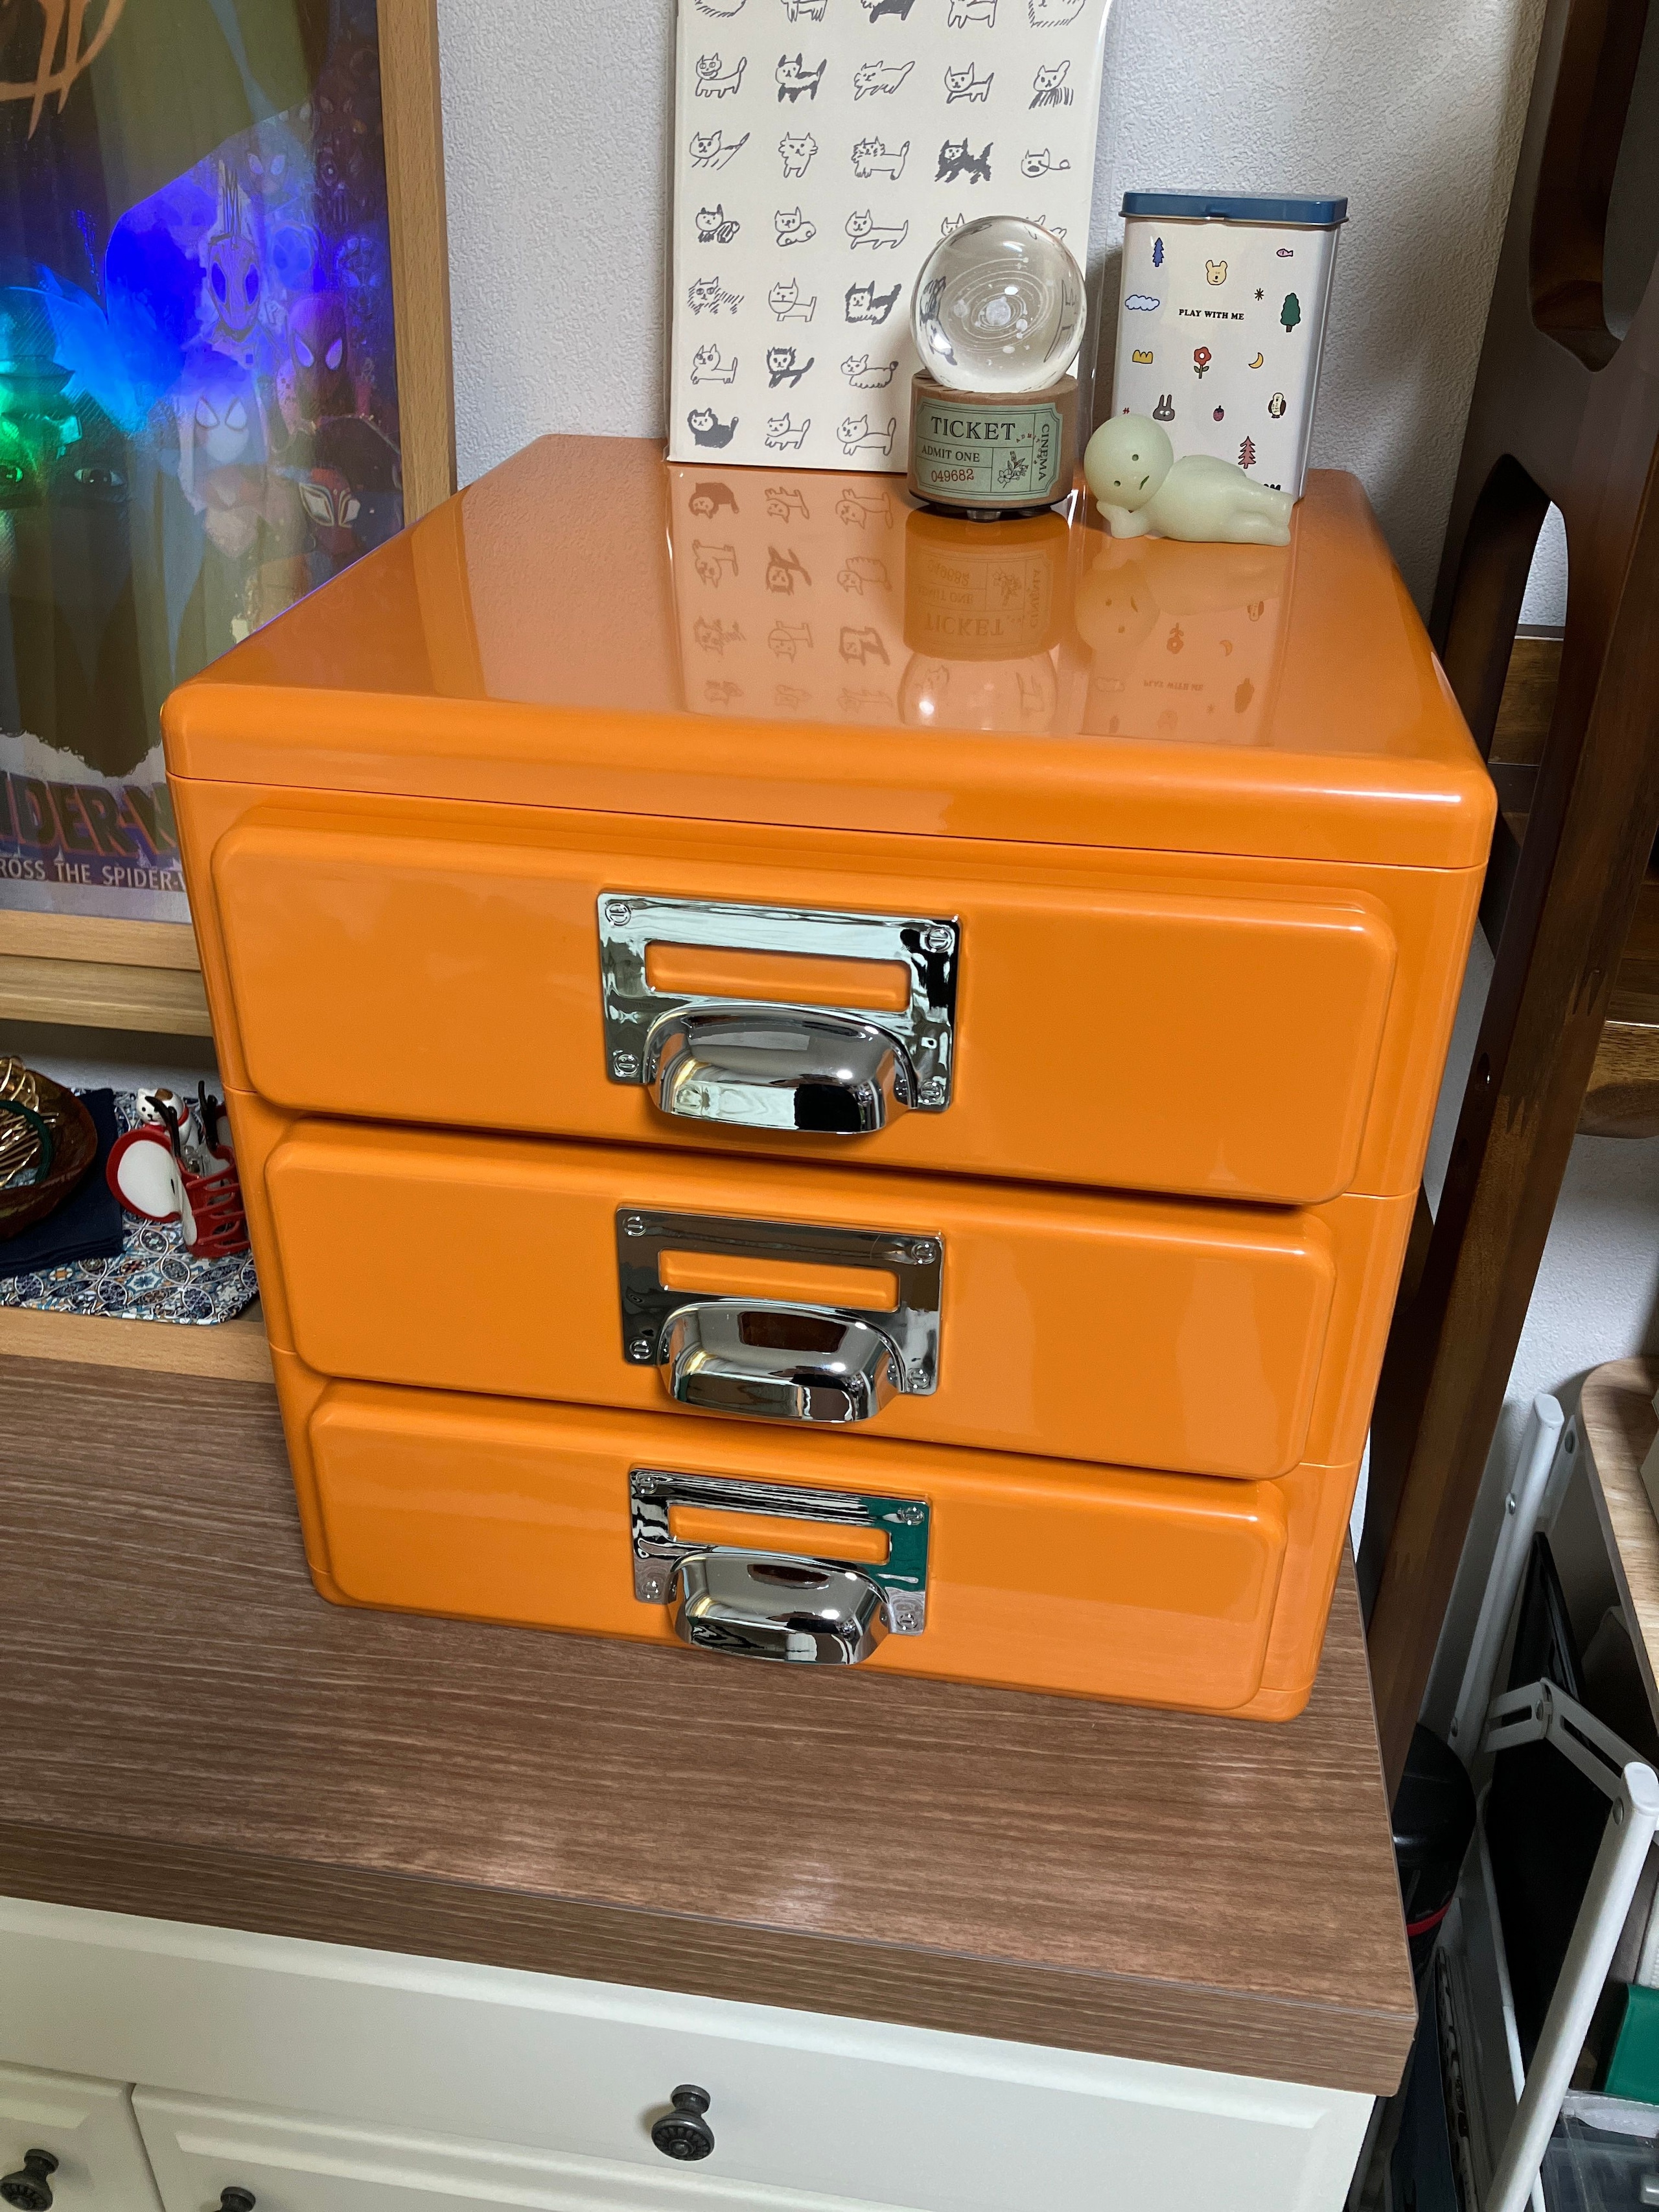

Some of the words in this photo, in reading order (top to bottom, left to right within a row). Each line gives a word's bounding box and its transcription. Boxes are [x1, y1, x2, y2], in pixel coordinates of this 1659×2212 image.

[1179, 309, 1201, 317] PLAY
[1204, 310, 1229, 319] WITH
[931, 416, 1015, 440] TICKET
[922, 445, 952, 459] ADMIT
[955, 451, 980, 462] ONE
[1038, 423, 1050, 481] CINEMA
[931, 469, 974, 482] 049682
[54, 861, 91, 884] THE
